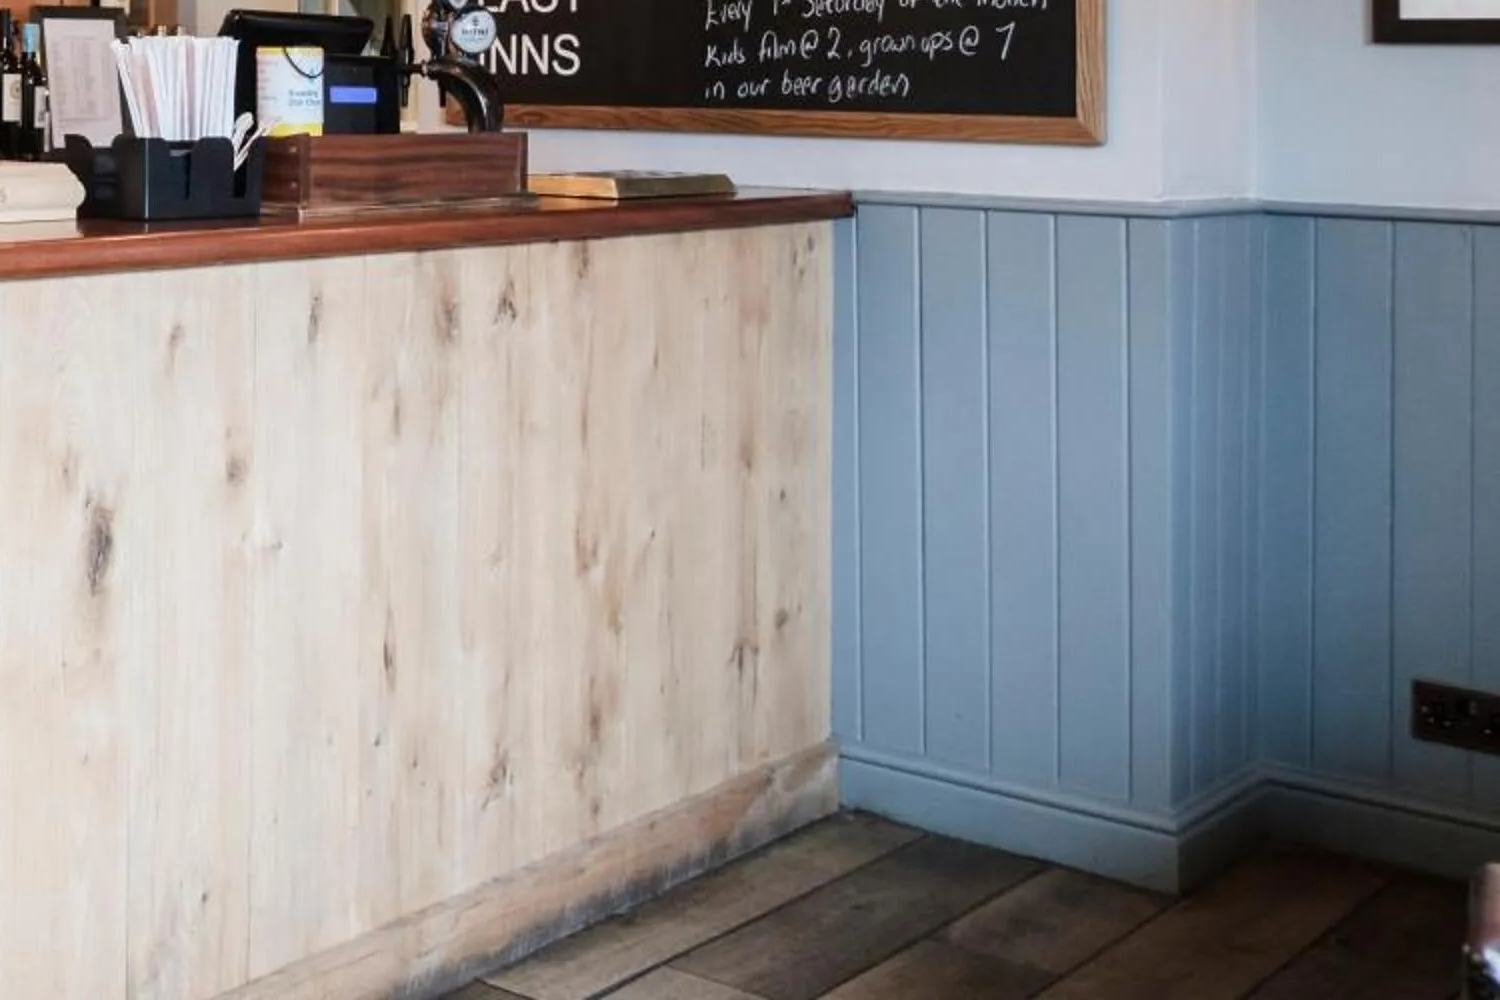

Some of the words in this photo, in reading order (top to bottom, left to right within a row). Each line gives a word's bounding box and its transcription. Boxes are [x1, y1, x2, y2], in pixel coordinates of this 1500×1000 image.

[859, 38, 915, 68] grown
[704, 82, 725, 100] in
[737, 78, 770, 98] our
[781, 69, 819, 96] beer
[827, 68, 912, 102] garden
